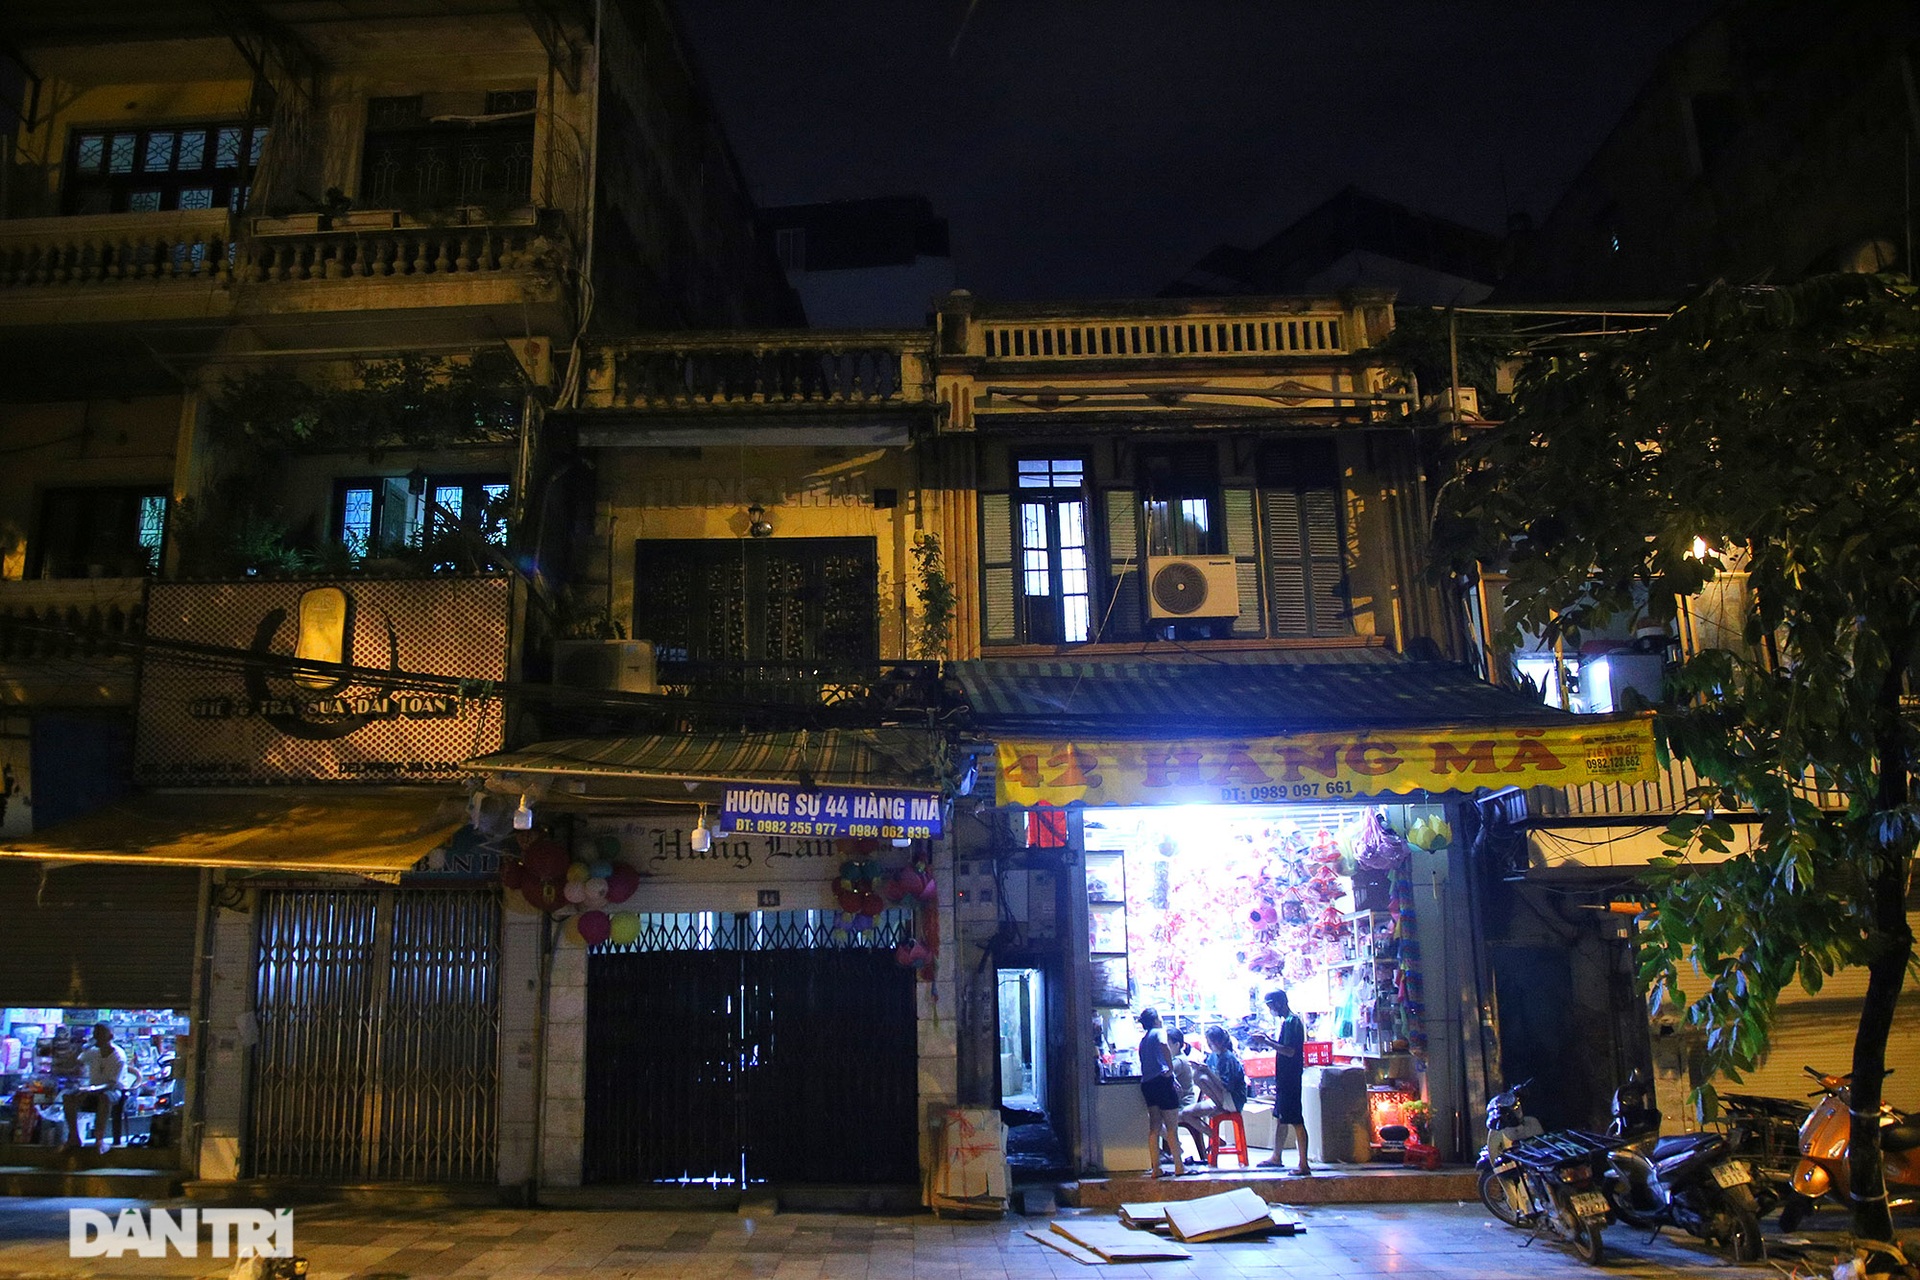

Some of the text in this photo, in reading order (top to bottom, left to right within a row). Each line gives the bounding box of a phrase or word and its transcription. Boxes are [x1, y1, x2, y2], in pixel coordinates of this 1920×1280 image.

[1005, 730, 1567, 789] 42 HÀNG MÃ
[1250, 785, 1288, 800] 0989
[1293, 783, 1320, 797] 097
[1326, 780, 1353, 794] 661
[725, 789, 790, 815] HƯƠNG
[825, 795, 849, 818] 44
[853, 792, 905, 820] HÀNG
[910, 794, 941, 821] MÃ
[735, 818, 754, 832] ĐT:
[757, 819, 787, 834] 0982
[790, 821, 812, 835] 255
[815, 823, 837, 836] 977
[849, 824, 879, 838] 0984
[881, 825, 905, 838] 062
